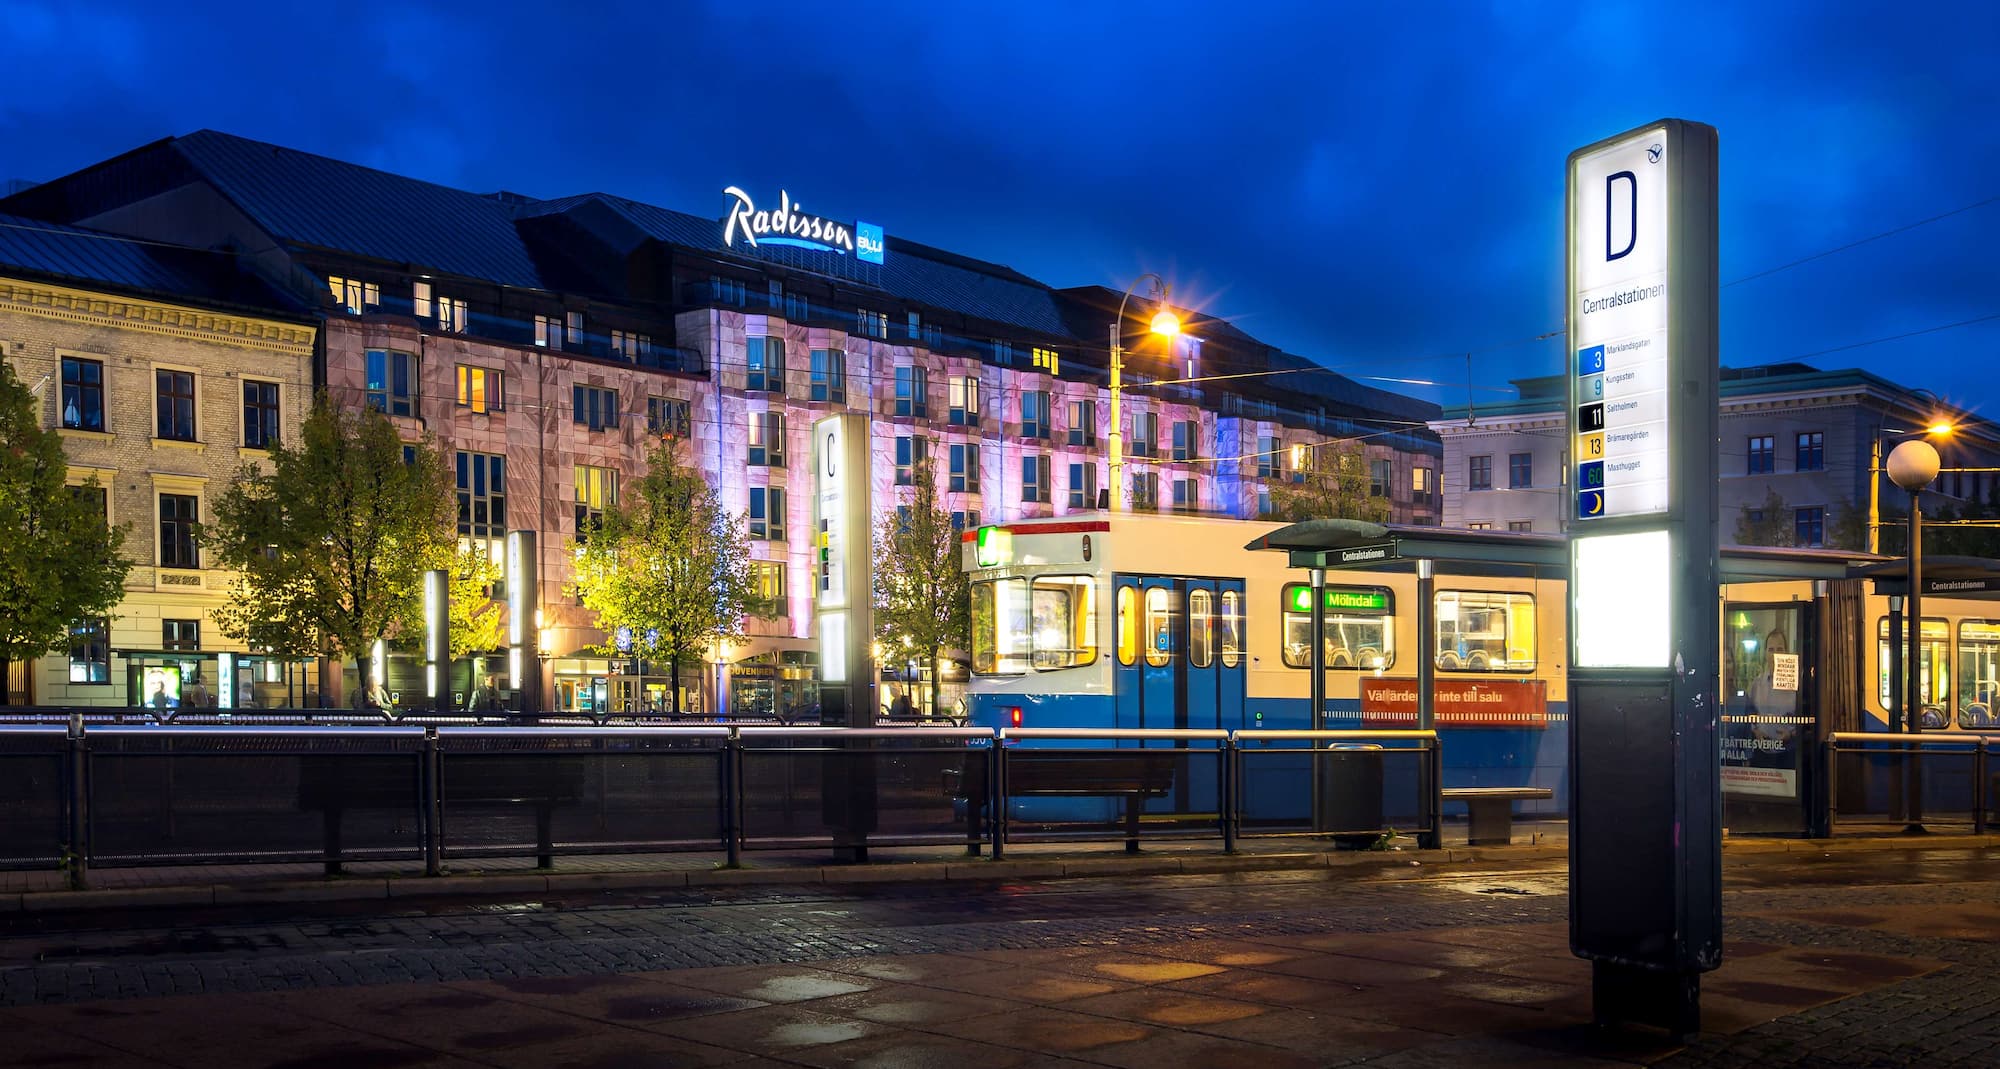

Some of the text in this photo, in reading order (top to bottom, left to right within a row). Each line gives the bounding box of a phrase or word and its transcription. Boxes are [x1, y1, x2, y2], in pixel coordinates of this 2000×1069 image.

[723, 186, 853, 250] Radisson
[1606, 171, 1637, 262] D
[1583, 282, 1666, 315] Centralstationen
[1594, 338, 1651, 369] 3 Marklandsgatan
[1594, 371, 1635, 396] 9 Kungssten
[1592, 400, 1638, 425] 11 Saltholmen
[827, 432, 836, 478] C
[1590, 430, 1649, 455] 13 Brämaregården
[1588, 460, 1641, 485] 60 Masthugget
[1342, 548, 1385, 562] Centralstationen
[1931, 580, 1986, 592] Centralstationen
[1328, 593, 1373, 607] Mölndal
[1439, 691, 1461, 702] inte
[1463, 691, 1477, 702] till
[1479, 692, 1502, 703] salu
[1725, 736, 1751, 749] BÄTTRE
[1752, 739, 1786, 750] SVERIGE.
[1727, 750, 1748, 760] ALLA.
